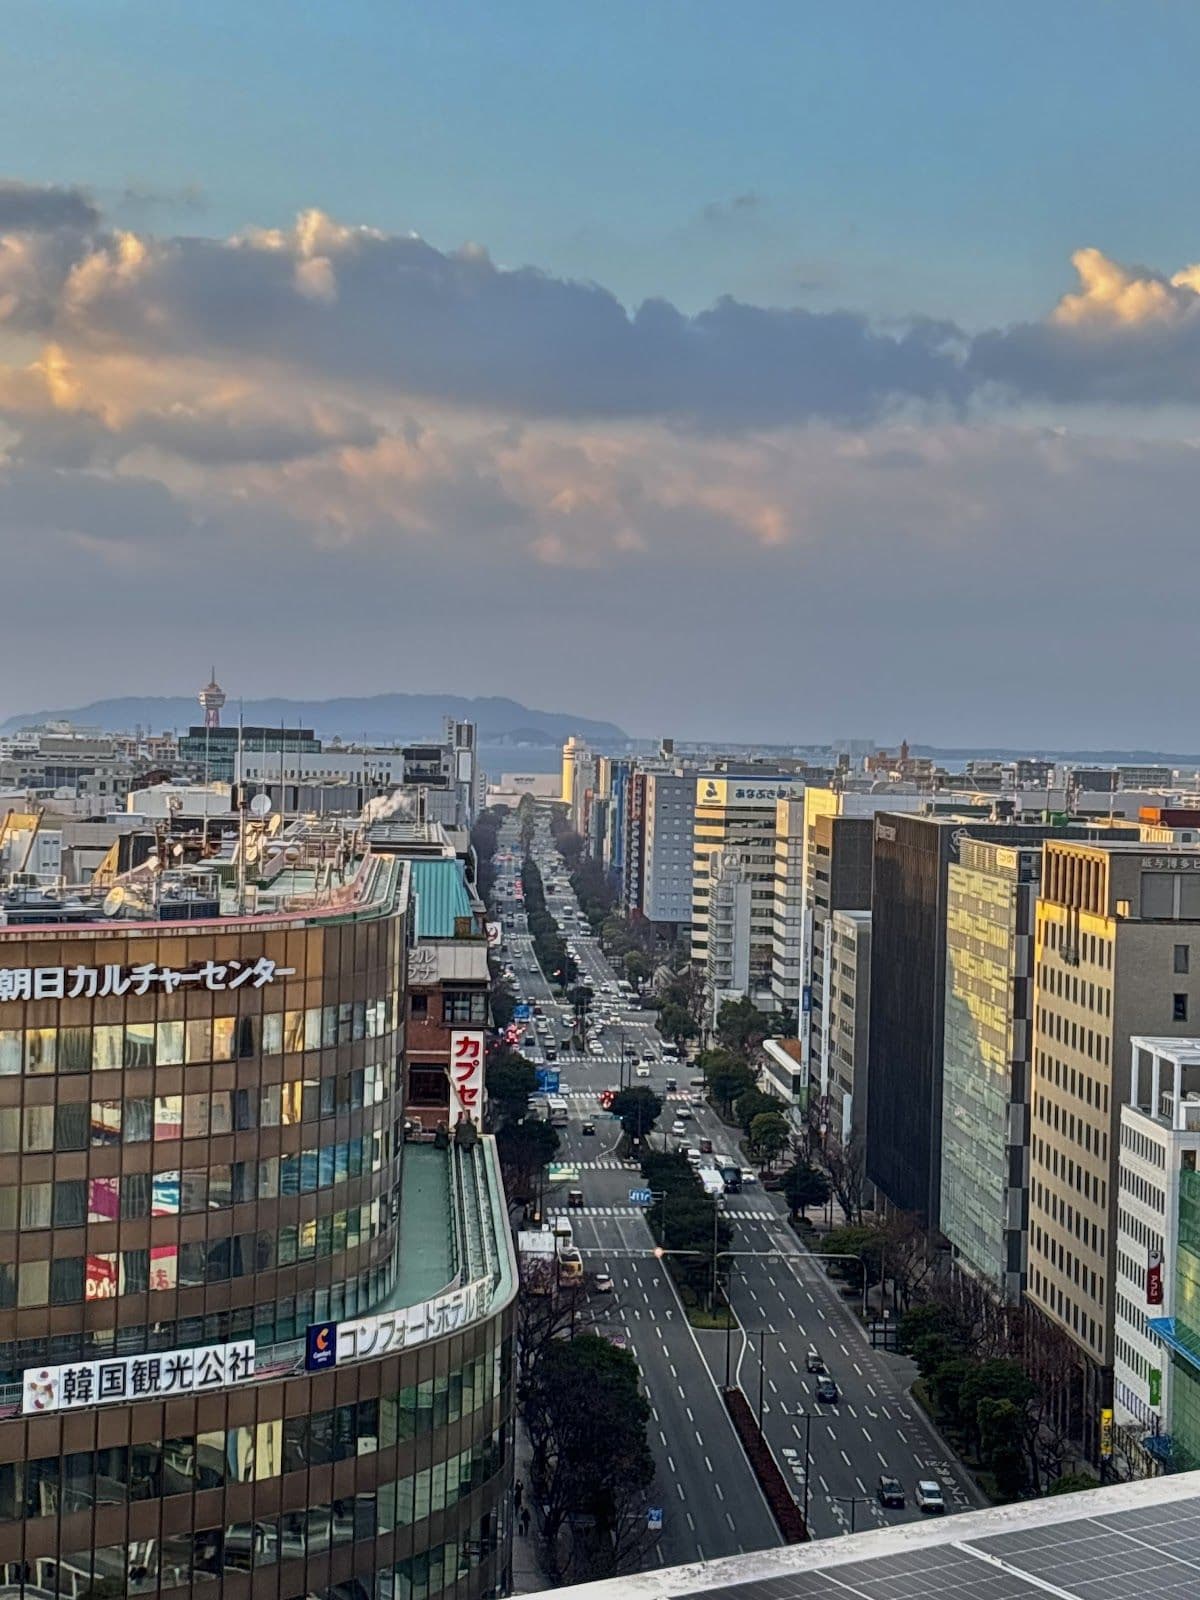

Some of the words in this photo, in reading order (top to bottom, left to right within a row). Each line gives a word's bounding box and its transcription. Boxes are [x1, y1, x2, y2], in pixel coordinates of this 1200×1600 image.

[0, 957, 296, 1000] 朝日カルチャーセンター
[63, 1345, 255, 1405] 韓国観光公社
